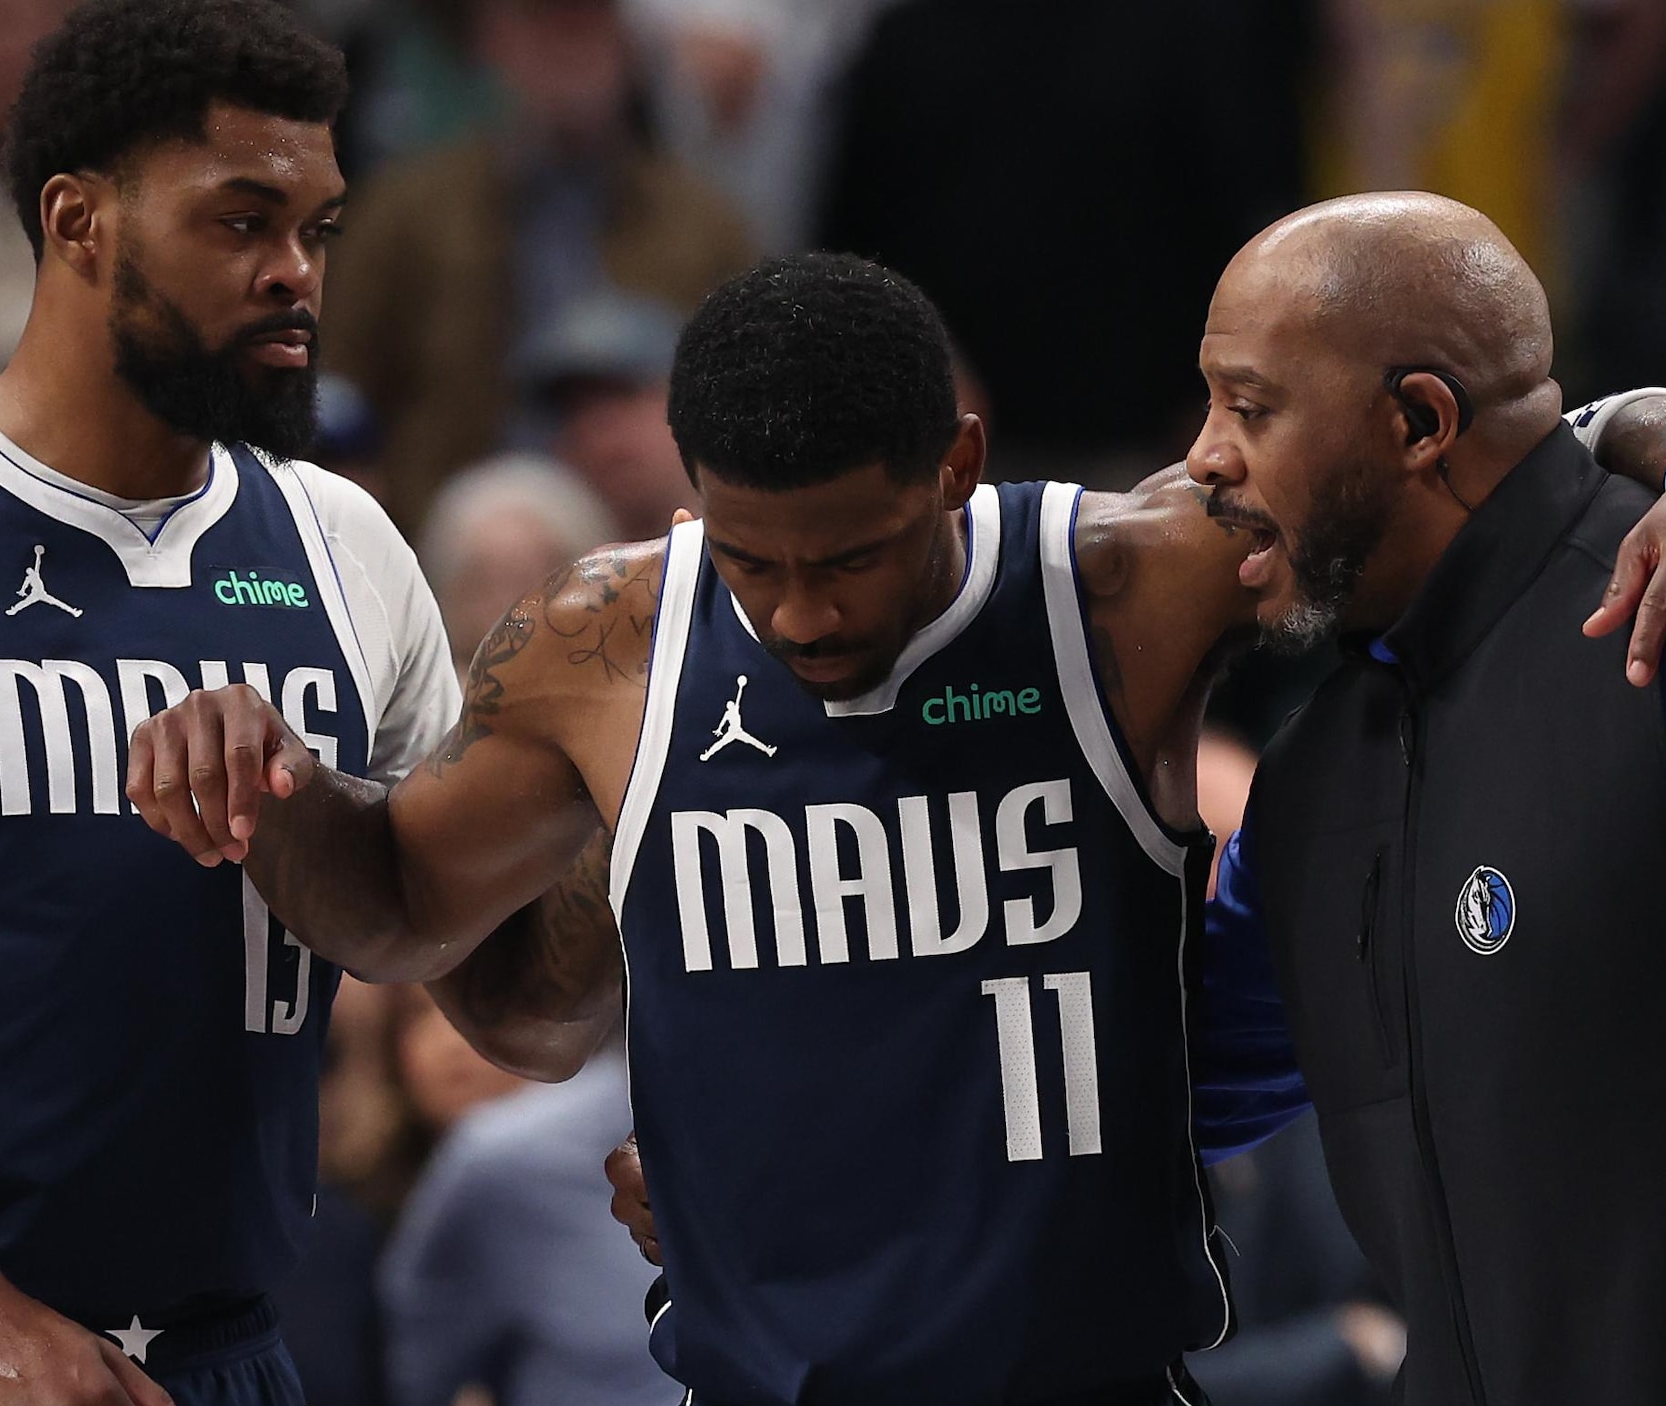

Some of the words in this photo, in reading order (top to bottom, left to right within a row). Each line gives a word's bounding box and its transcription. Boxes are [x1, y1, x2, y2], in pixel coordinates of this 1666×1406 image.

[214, 569, 310, 609] chime
[921, 682, 1042, 727] chime
[670, 778, 1083, 973] MAVS
[981, 971, 1103, 1162] 11
